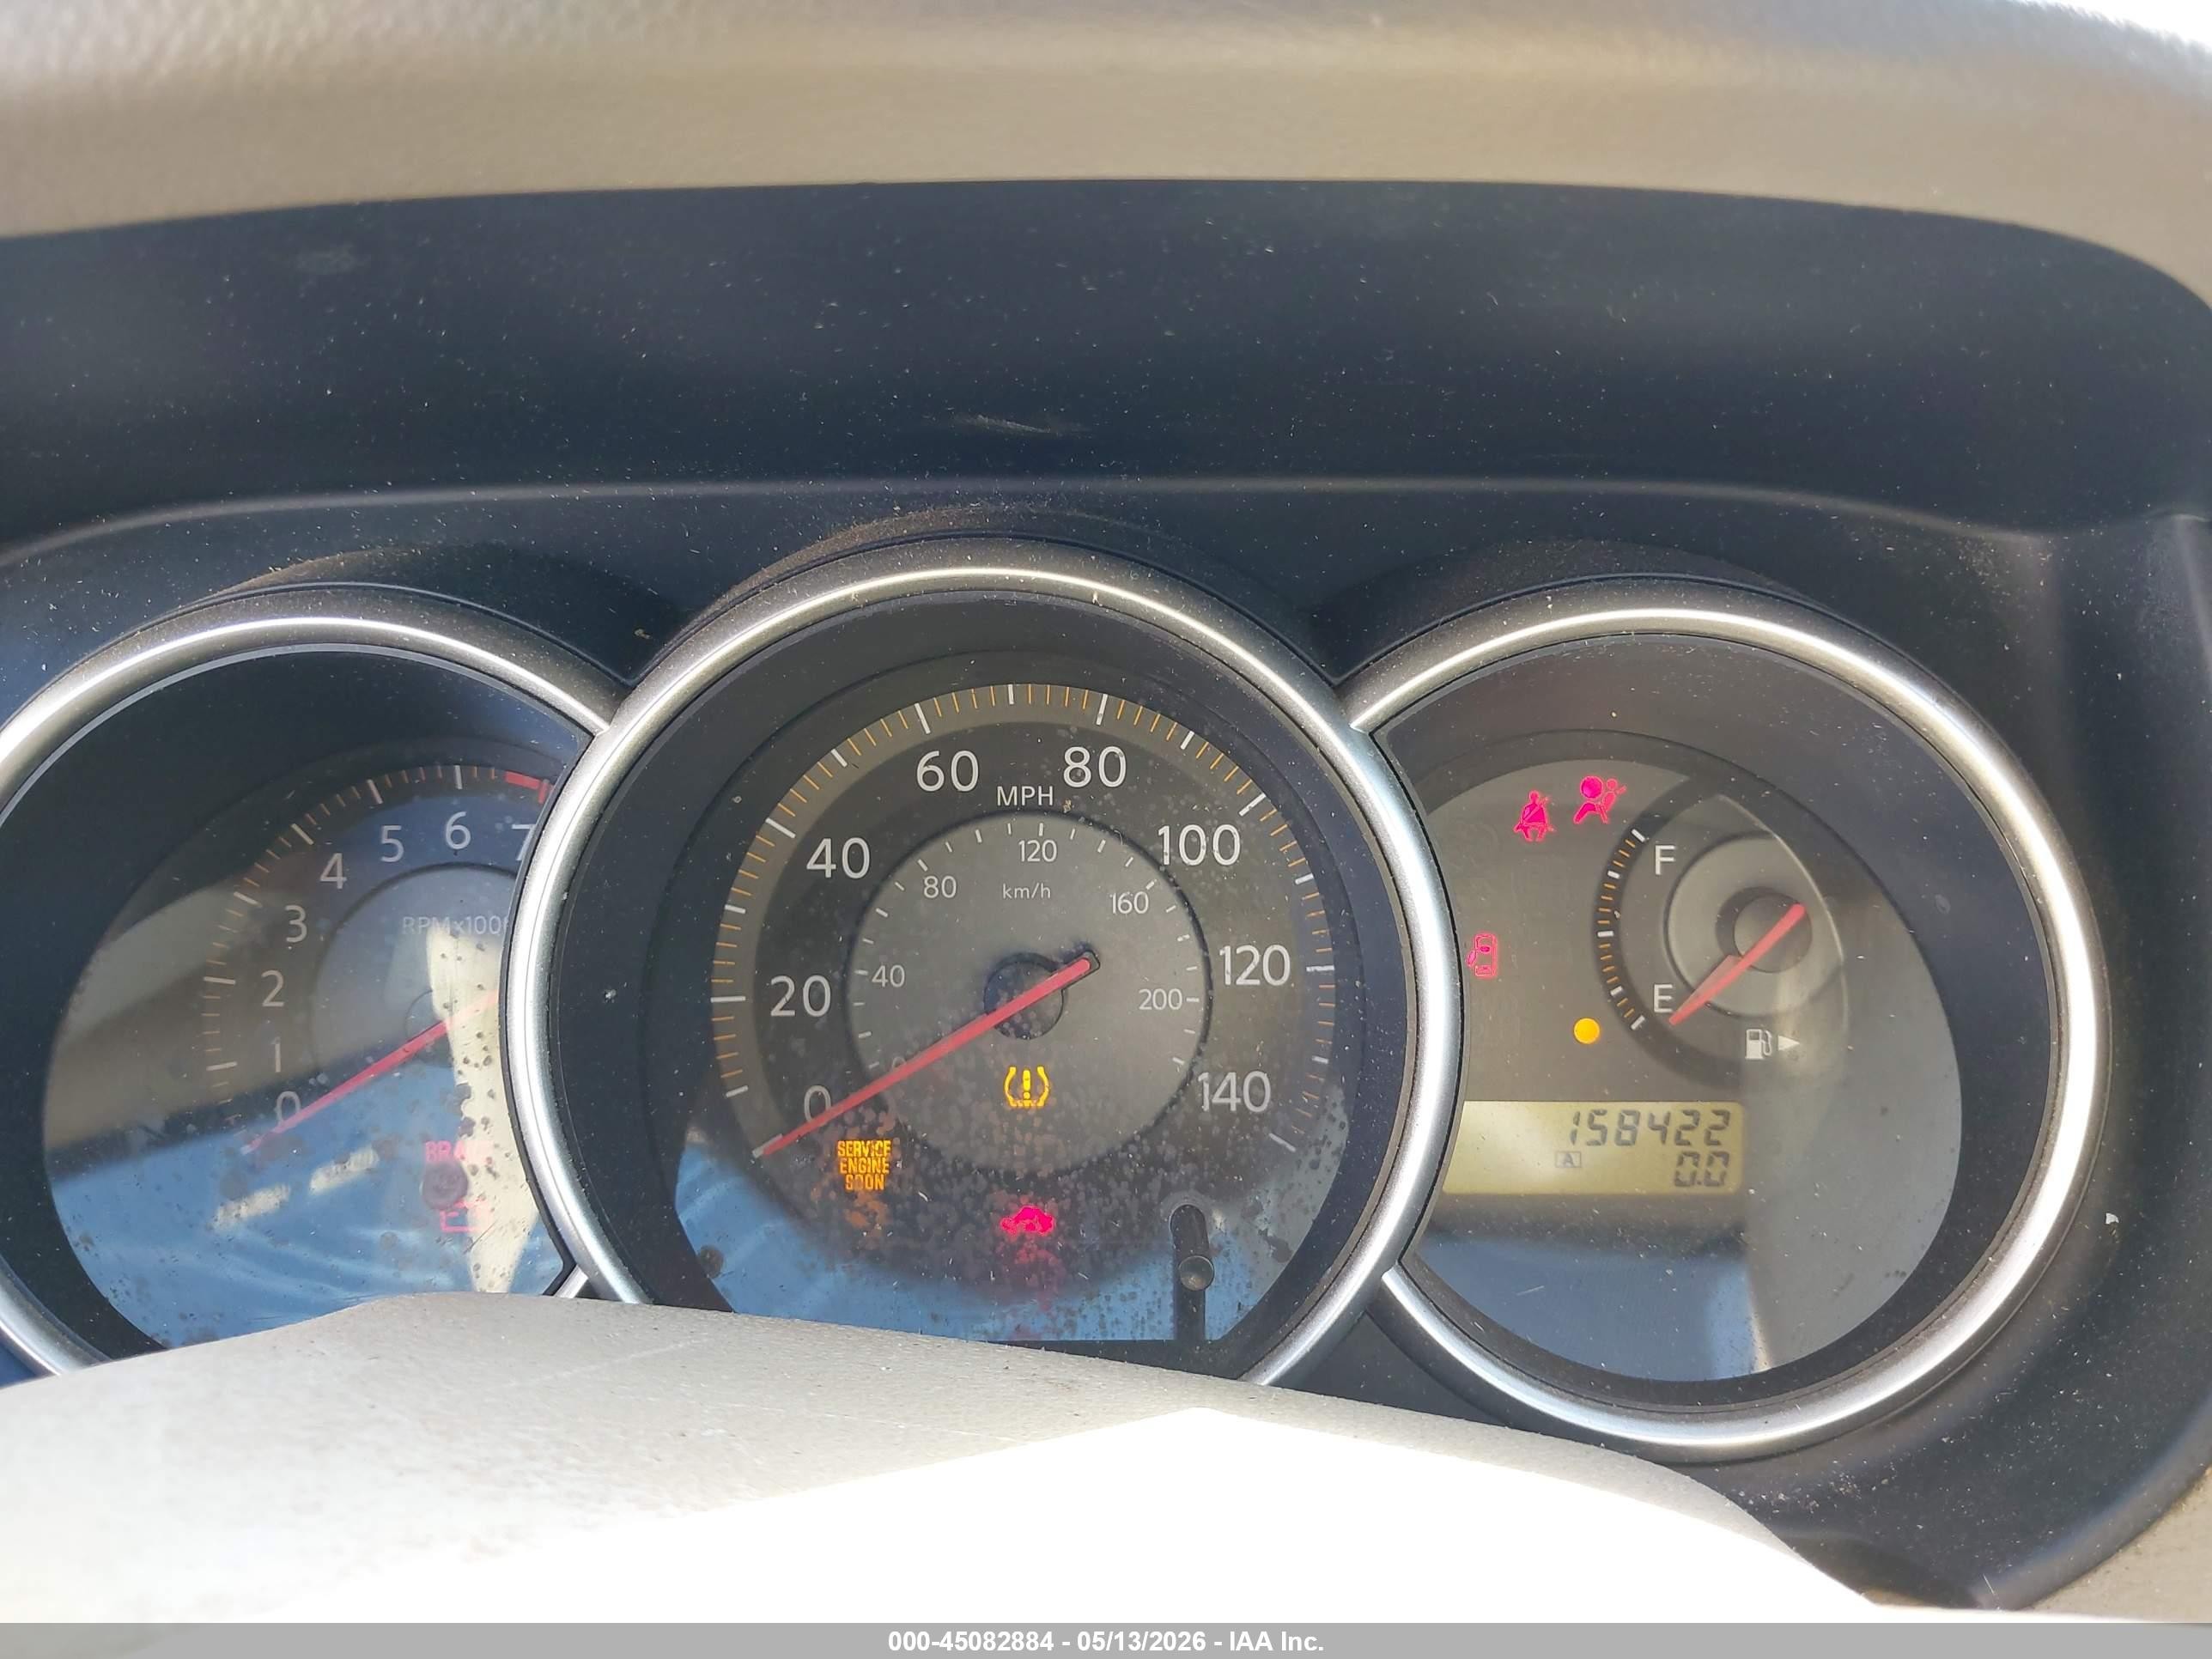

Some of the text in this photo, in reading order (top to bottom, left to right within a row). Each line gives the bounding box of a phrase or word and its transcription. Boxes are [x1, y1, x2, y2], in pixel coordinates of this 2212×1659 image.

[916, 750, 979, 792] 60
[1062, 745, 1127, 787] 80
[996, 785, 1054, 806] MPH
[381, 824, 404, 863] 5
[445, 811, 471, 850] 6
[511, 823, 537, 861] 7
[1158, 824, 1241, 866] 100
[805, 837, 870, 878] 40
[1018, 839, 1057, 862] 120
[1655, 844, 1675, 875] F
[319, 852, 347, 890] 4
[922, 875, 957, 899] 80
[1002, 883, 1052, 900] km/h
[1111, 890, 1149, 914] 160
[284, 904, 307, 943] 3
[872, 964, 906, 988] 40
[1218, 944, 1291, 986] 120
[261, 969, 284, 1007] 2
[770, 975, 831, 1017] 20
[1139, 988, 1182, 1010] 200
[1653, 984, 1673, 1012] E
[271, 1036, 282, 1073] 1
[275, 1090, 301, 1127] 0
[804, 1085, 832, 1123] 0
[1197, 1071, 1271, 1112] 140
[1569, 1109, 1731, 1146] 158422
[837, 1139, 892, 1157] SERVICE
[840, 1157, 890, 1174] ENGINE
[1674, 1151, 1730, 1188] 0.0
